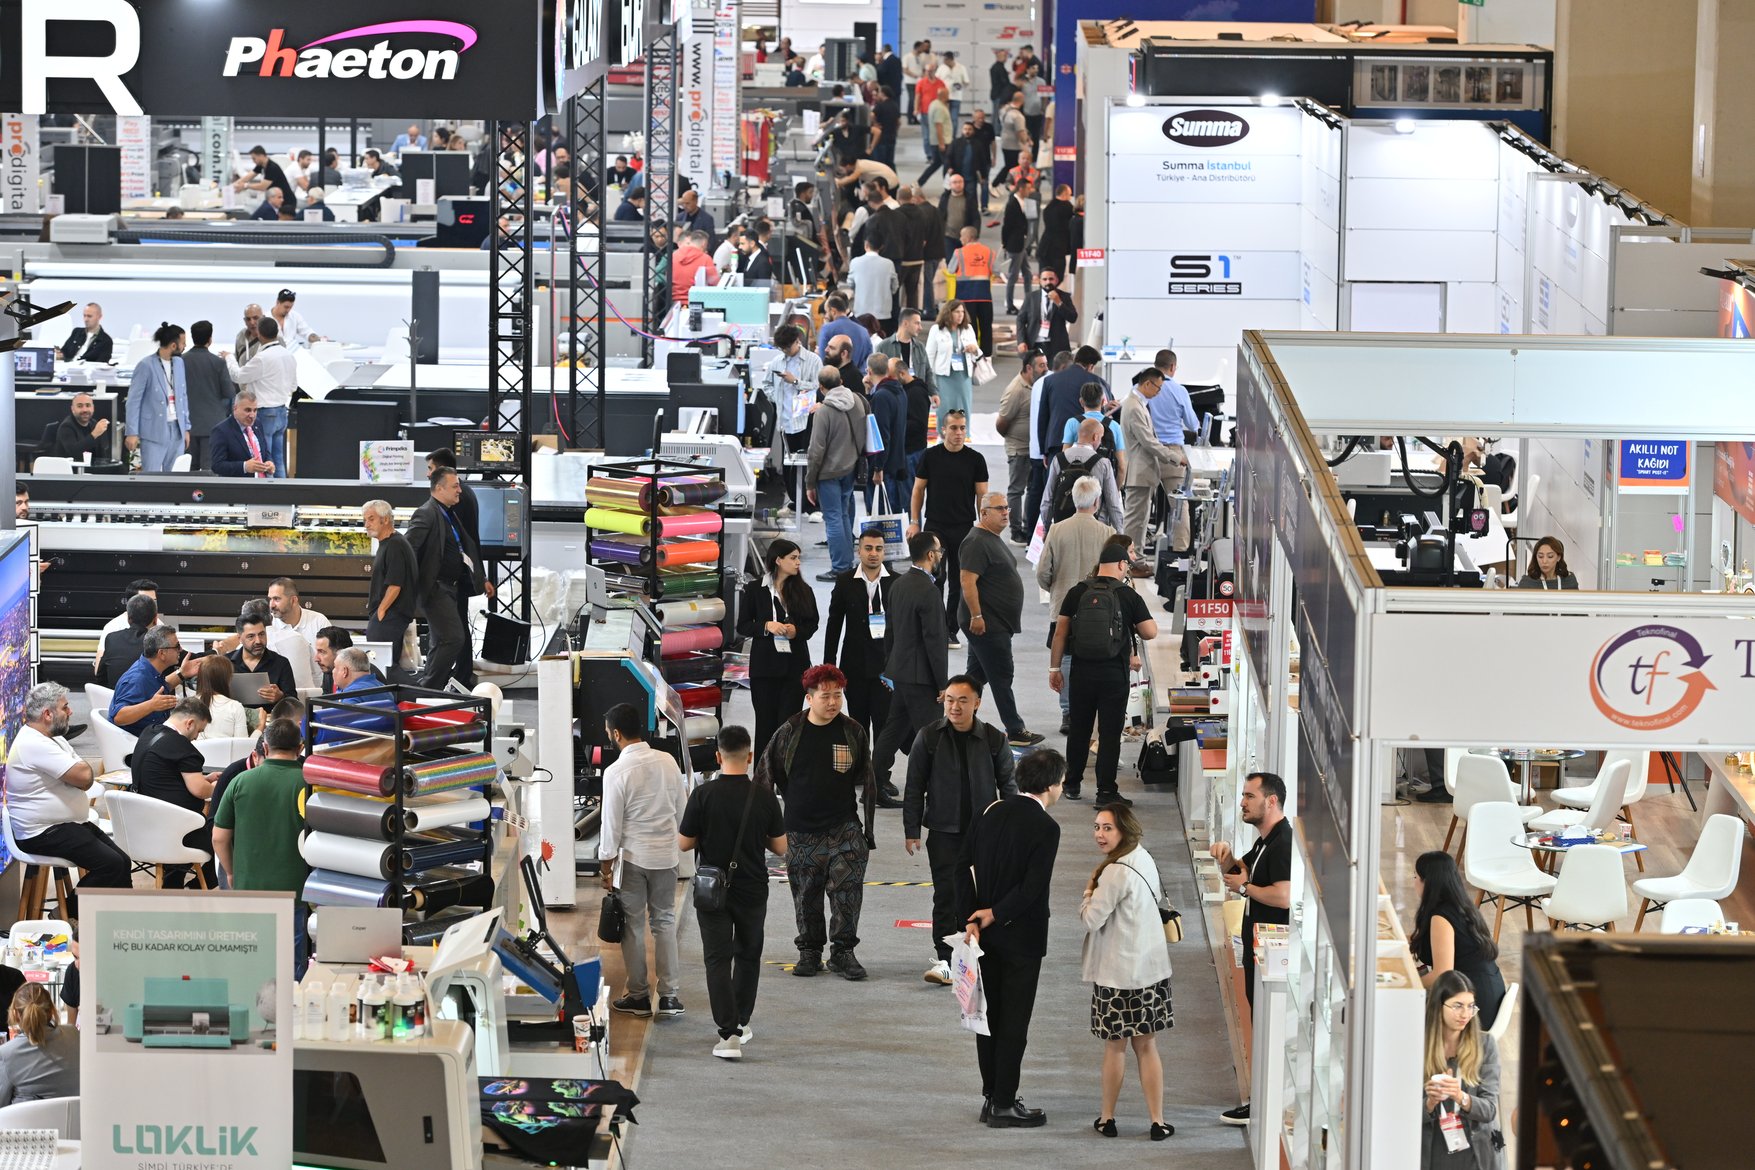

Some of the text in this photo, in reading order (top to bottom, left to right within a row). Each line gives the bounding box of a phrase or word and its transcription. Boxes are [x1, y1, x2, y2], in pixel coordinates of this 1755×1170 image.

[22, 0, 144, 115] R
[223, 29, 459, 80] Phaeton
[1169, 117, 1243, 137] Summa
[1162, 161, 1204, 170] Summa
[1157, 174, 1185, 182] Türkiye
[1170, 284, 1240, 293] SERIES
[1629, 443, 1679, 456] AKILLI NOT
[1637, 457, 1669, 469] KAĞIDI
[1223, 584, 1233, 592] 50
[1192, 602, 1230, 614] 11F50
[1636, 627, 1678, 639] Teknofinal
[1628, 650, 1671, 705] tf
[113, 929, 258, 941] KENDİ TASARIMINI ÜRETMEK
[113, 941, 129, 952] HİÇ
[131, 943, 144, 951] BU
[145, 943, 176, 951] KADAR
[177, 944, 206, 952] KOLAY
